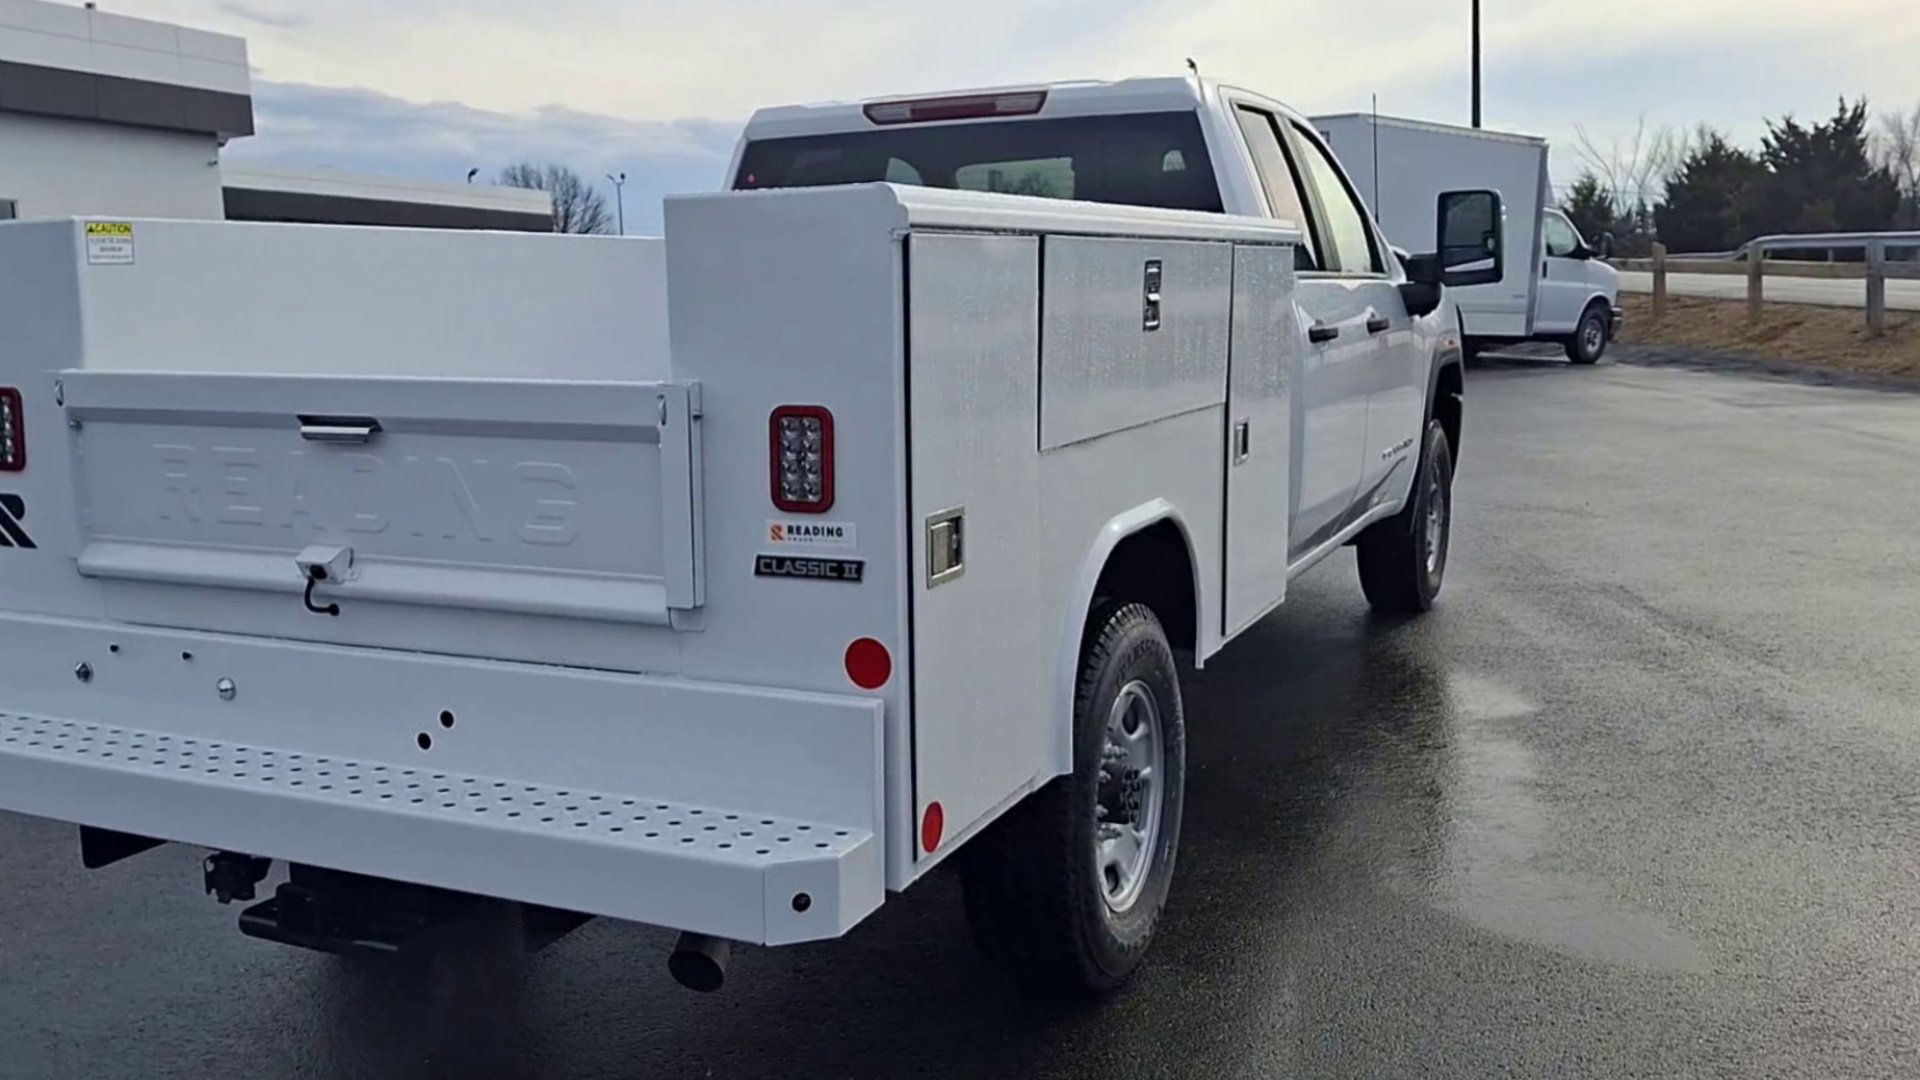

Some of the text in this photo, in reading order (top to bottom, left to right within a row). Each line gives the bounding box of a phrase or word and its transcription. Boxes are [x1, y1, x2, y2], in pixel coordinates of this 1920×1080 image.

[95, 223, 131, 233] CAUTION
[787, 525, 843, 537] READING
[760, 559, 838, 577] CLASSIC
